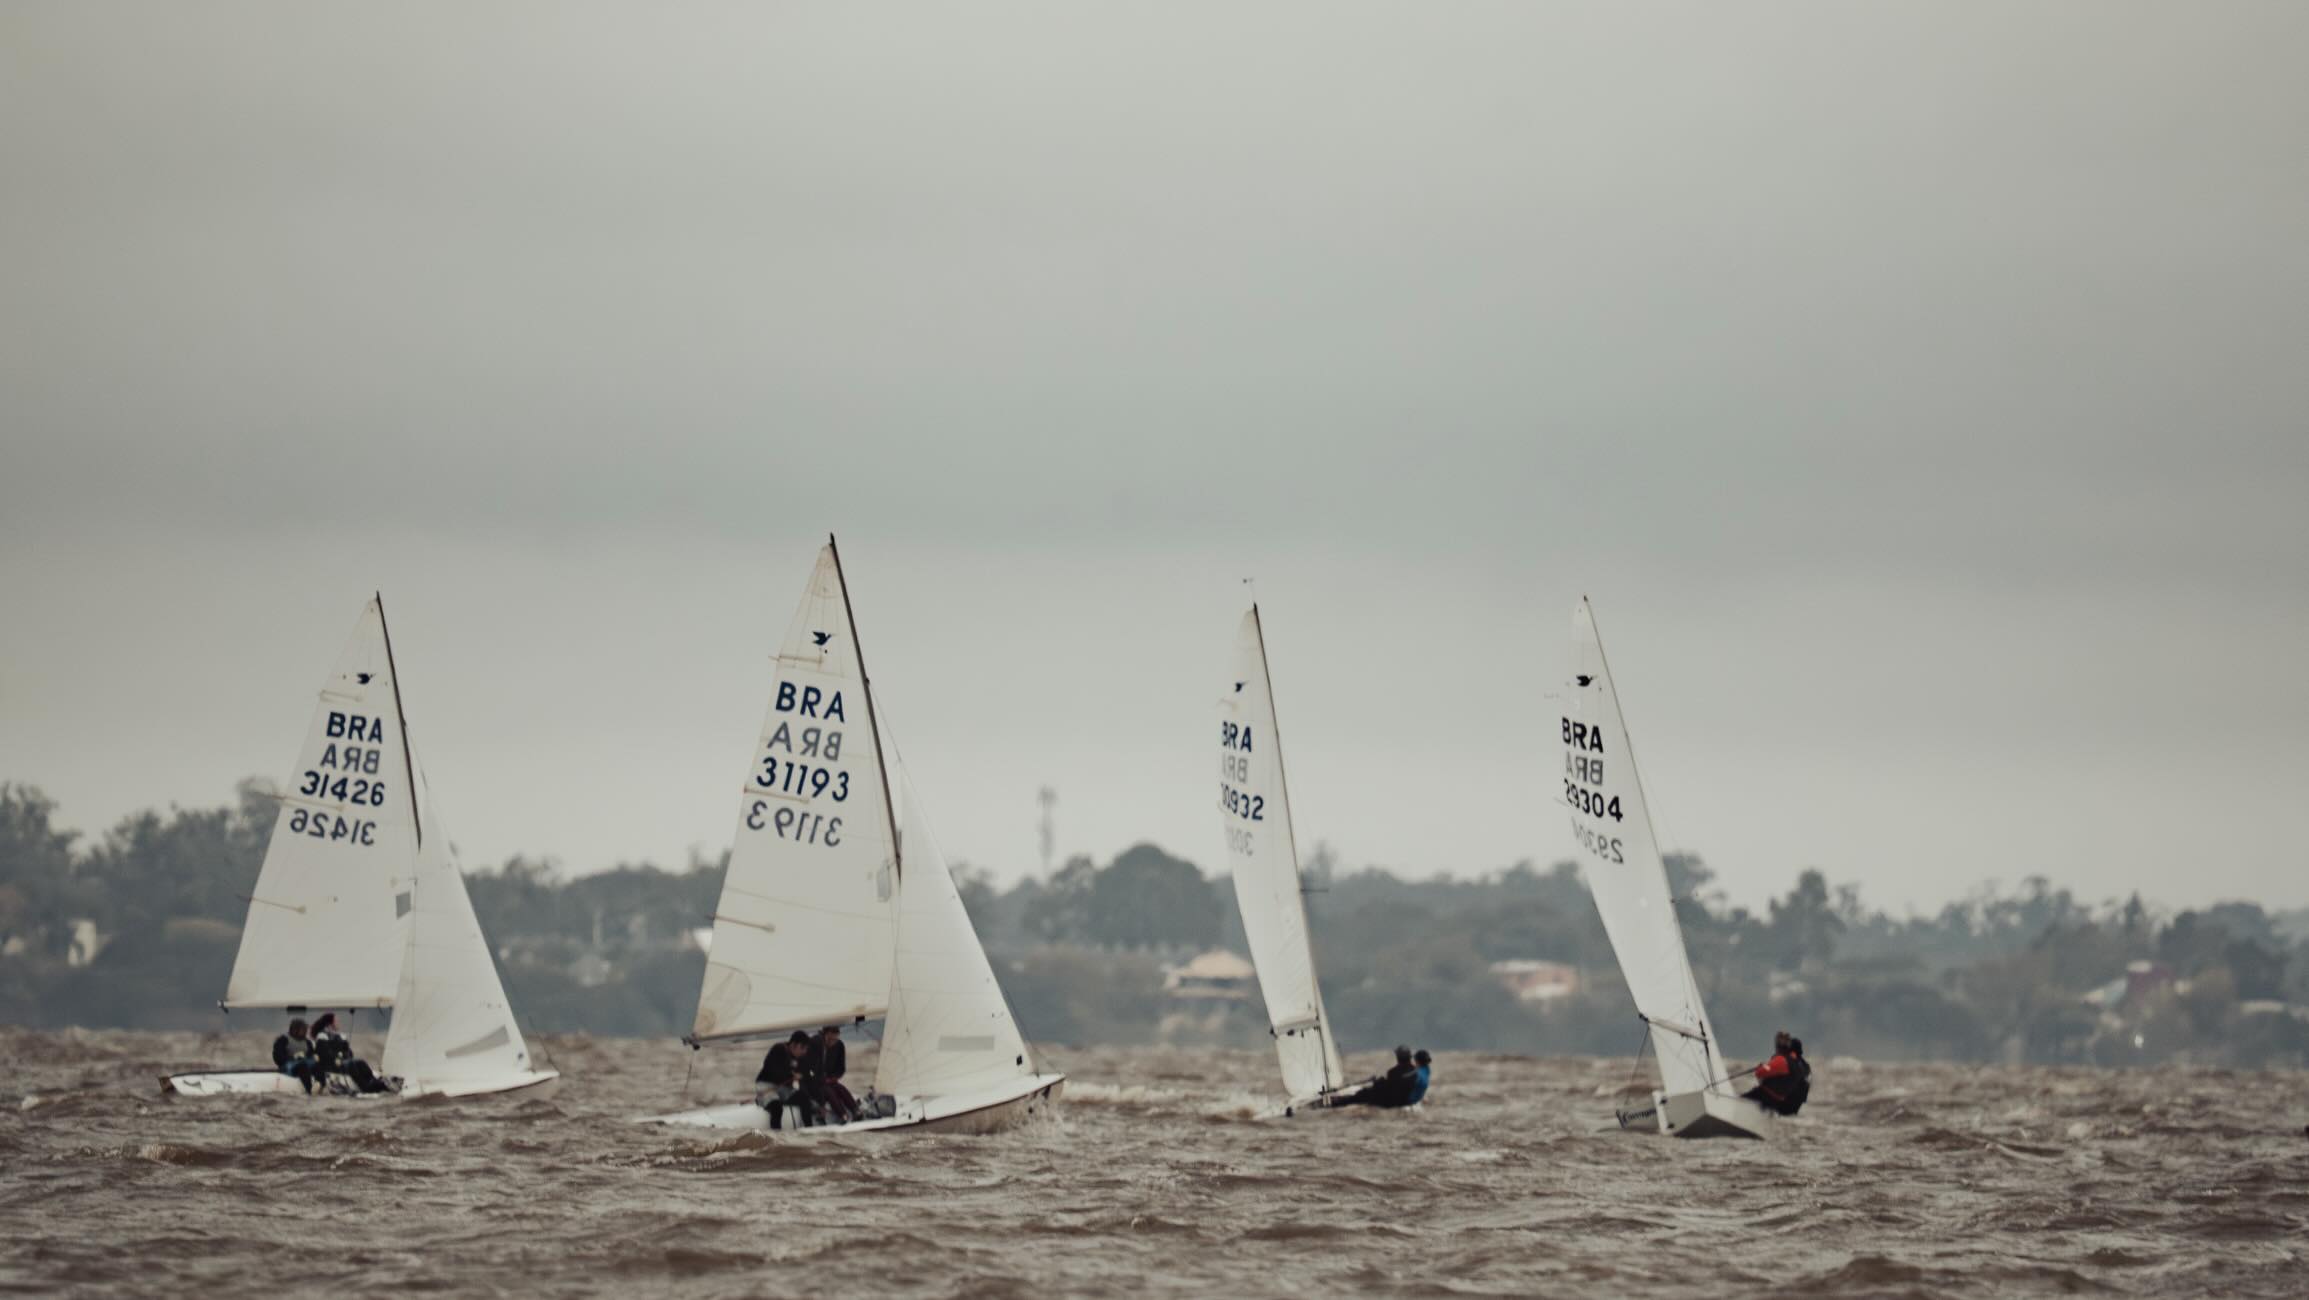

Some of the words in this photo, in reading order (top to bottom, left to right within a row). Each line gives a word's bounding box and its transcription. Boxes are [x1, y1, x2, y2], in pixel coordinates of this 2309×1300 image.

[775, 681, 845, 723] BRA
[326, 712, 383, 744] BRA
[1562, 716, 1604, 753] BRA
[300, 770, 385, 806] 31426
[756, 756, 849, 802] 31193
[1564, 778, 1624, 822] 29304
